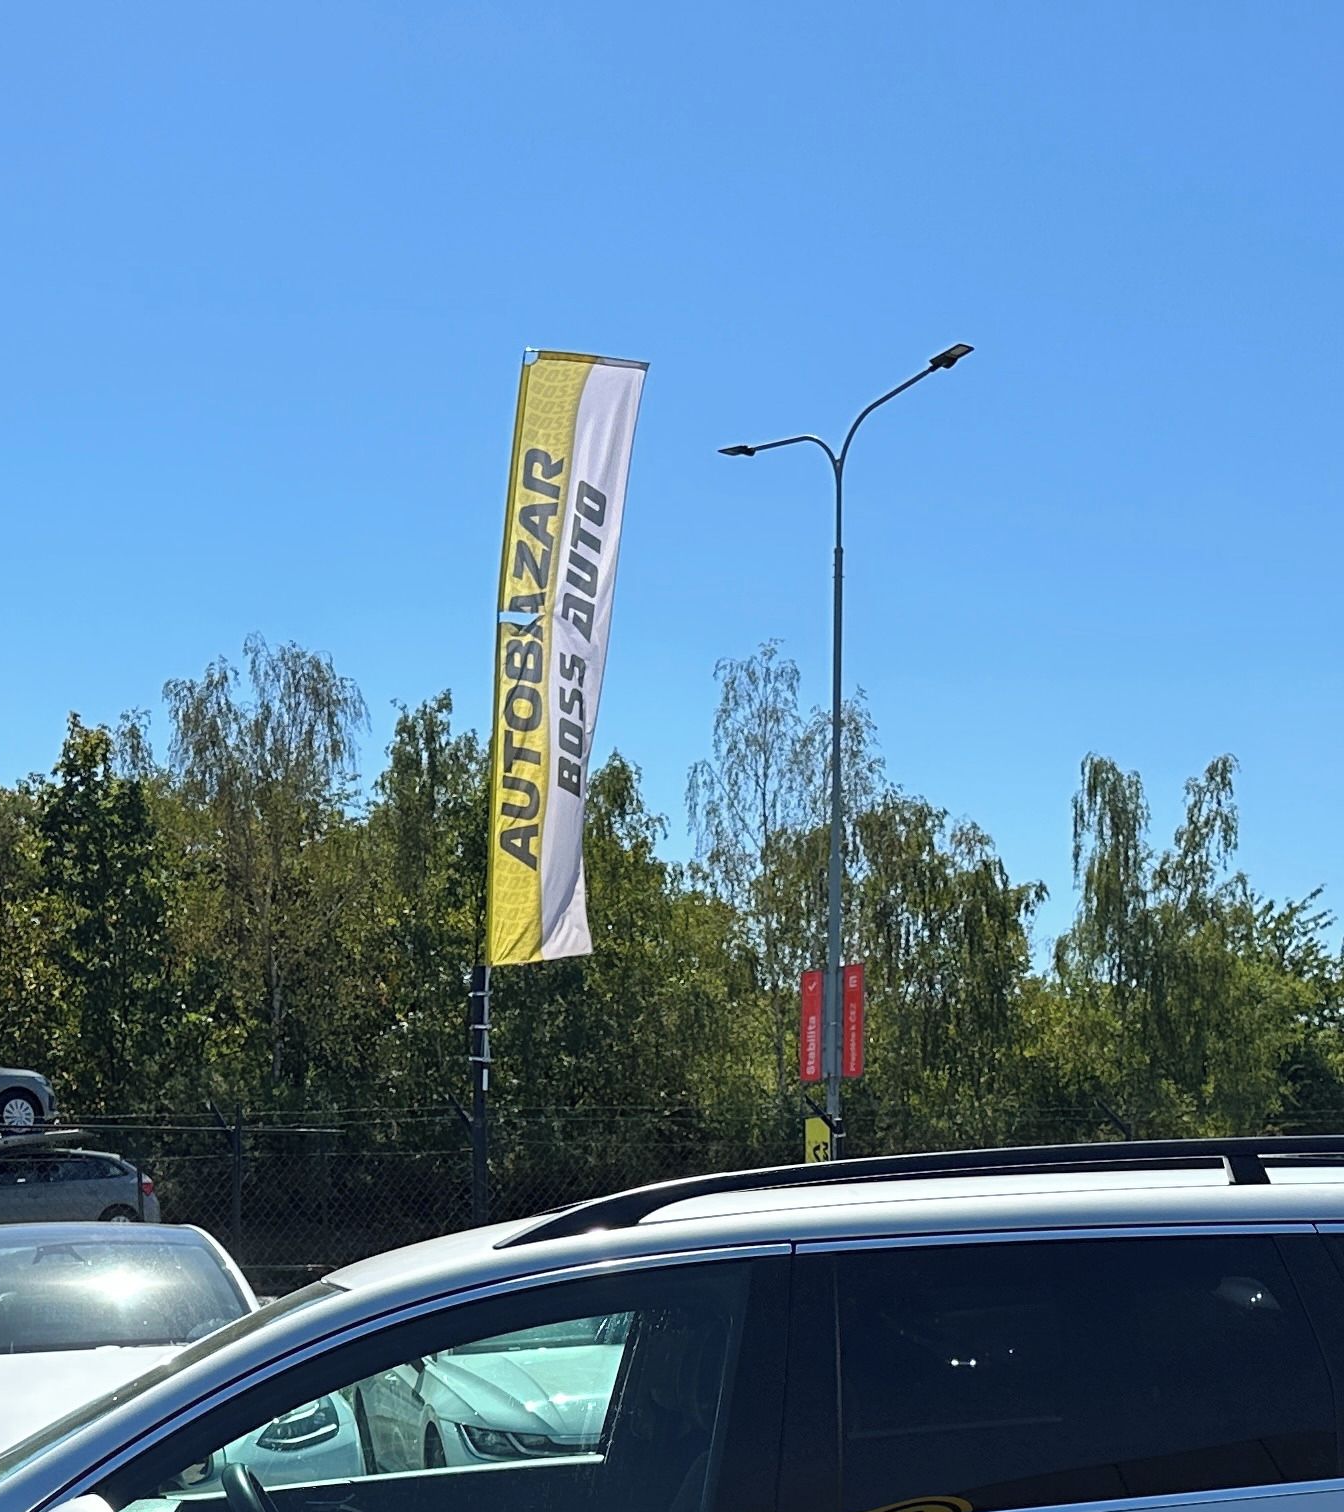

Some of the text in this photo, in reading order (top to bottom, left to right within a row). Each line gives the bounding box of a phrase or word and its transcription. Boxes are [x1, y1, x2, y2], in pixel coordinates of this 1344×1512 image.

[557, 480, 607, 799] BOSS AUTO
[805, 1015, 817, 1076] Stabilita
